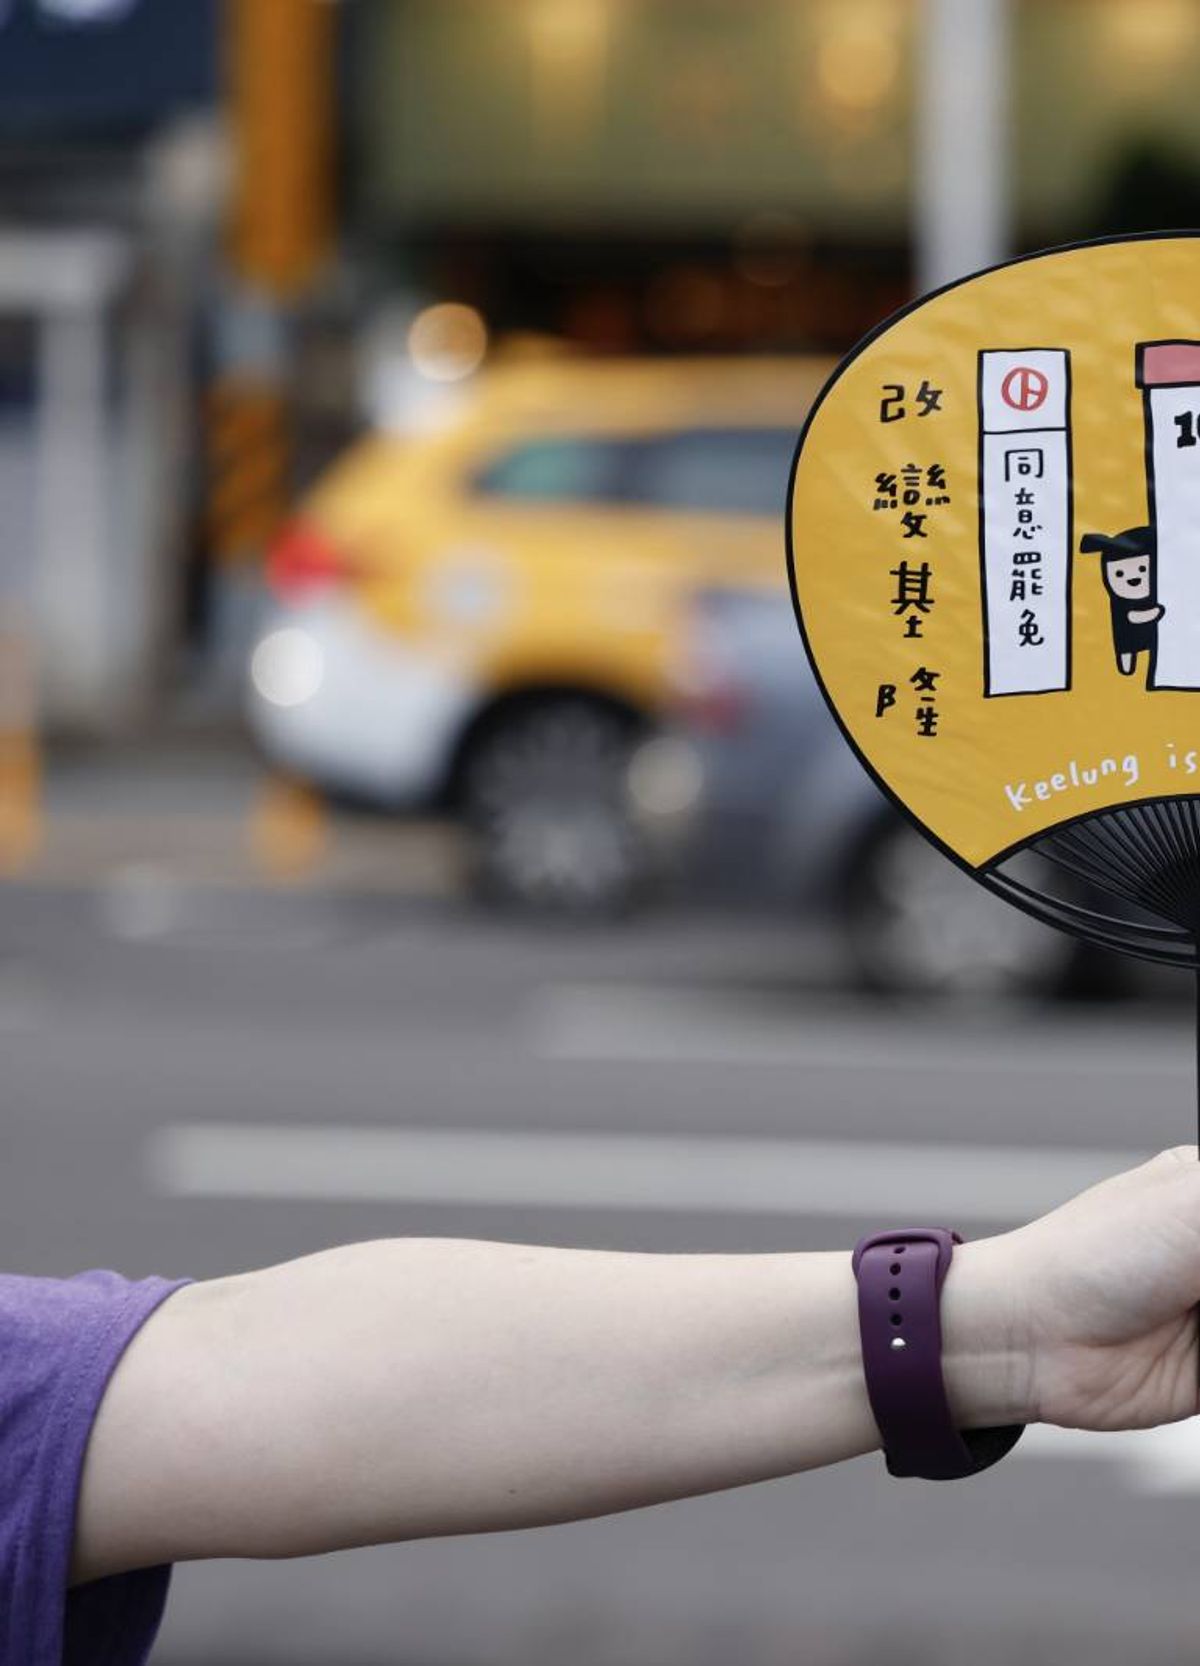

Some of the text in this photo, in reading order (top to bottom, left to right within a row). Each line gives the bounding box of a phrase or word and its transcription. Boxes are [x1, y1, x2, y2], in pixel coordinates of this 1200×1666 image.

[1002, 448, 1046, 647] 同意罷免
[1166, 743, 1198, 774] is
